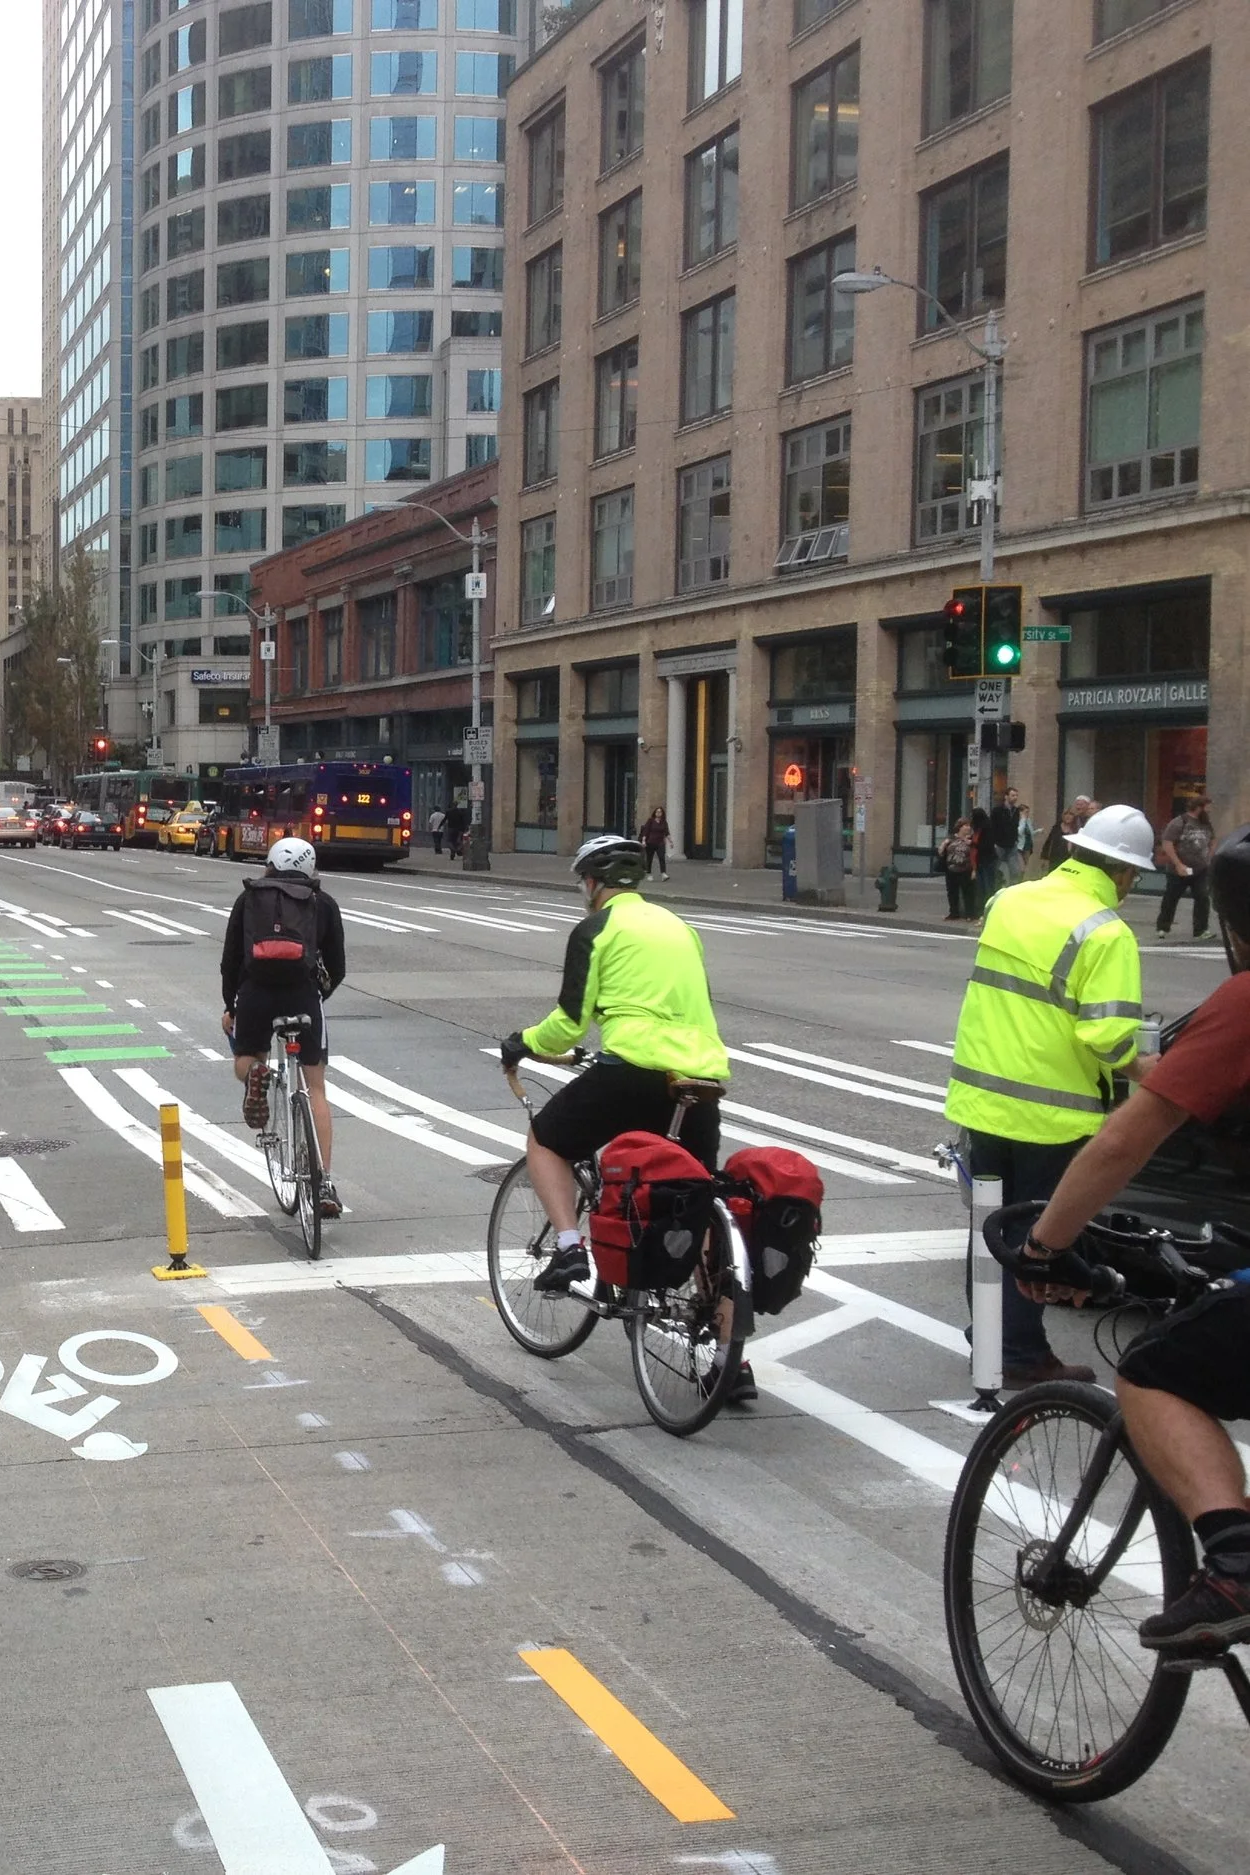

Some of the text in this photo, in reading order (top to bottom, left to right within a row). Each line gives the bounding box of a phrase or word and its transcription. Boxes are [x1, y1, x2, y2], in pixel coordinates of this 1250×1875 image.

[193, 671, 221, 681] Safeco
[979, 681, 1003, 691] ONE
[978, 692, 1003, 702] WAY
[1067, 689, 1114, 706] PATRICIA
[1117, 686, 1162, 704] ROVZAR
[357, 794, 371, 804] 122
